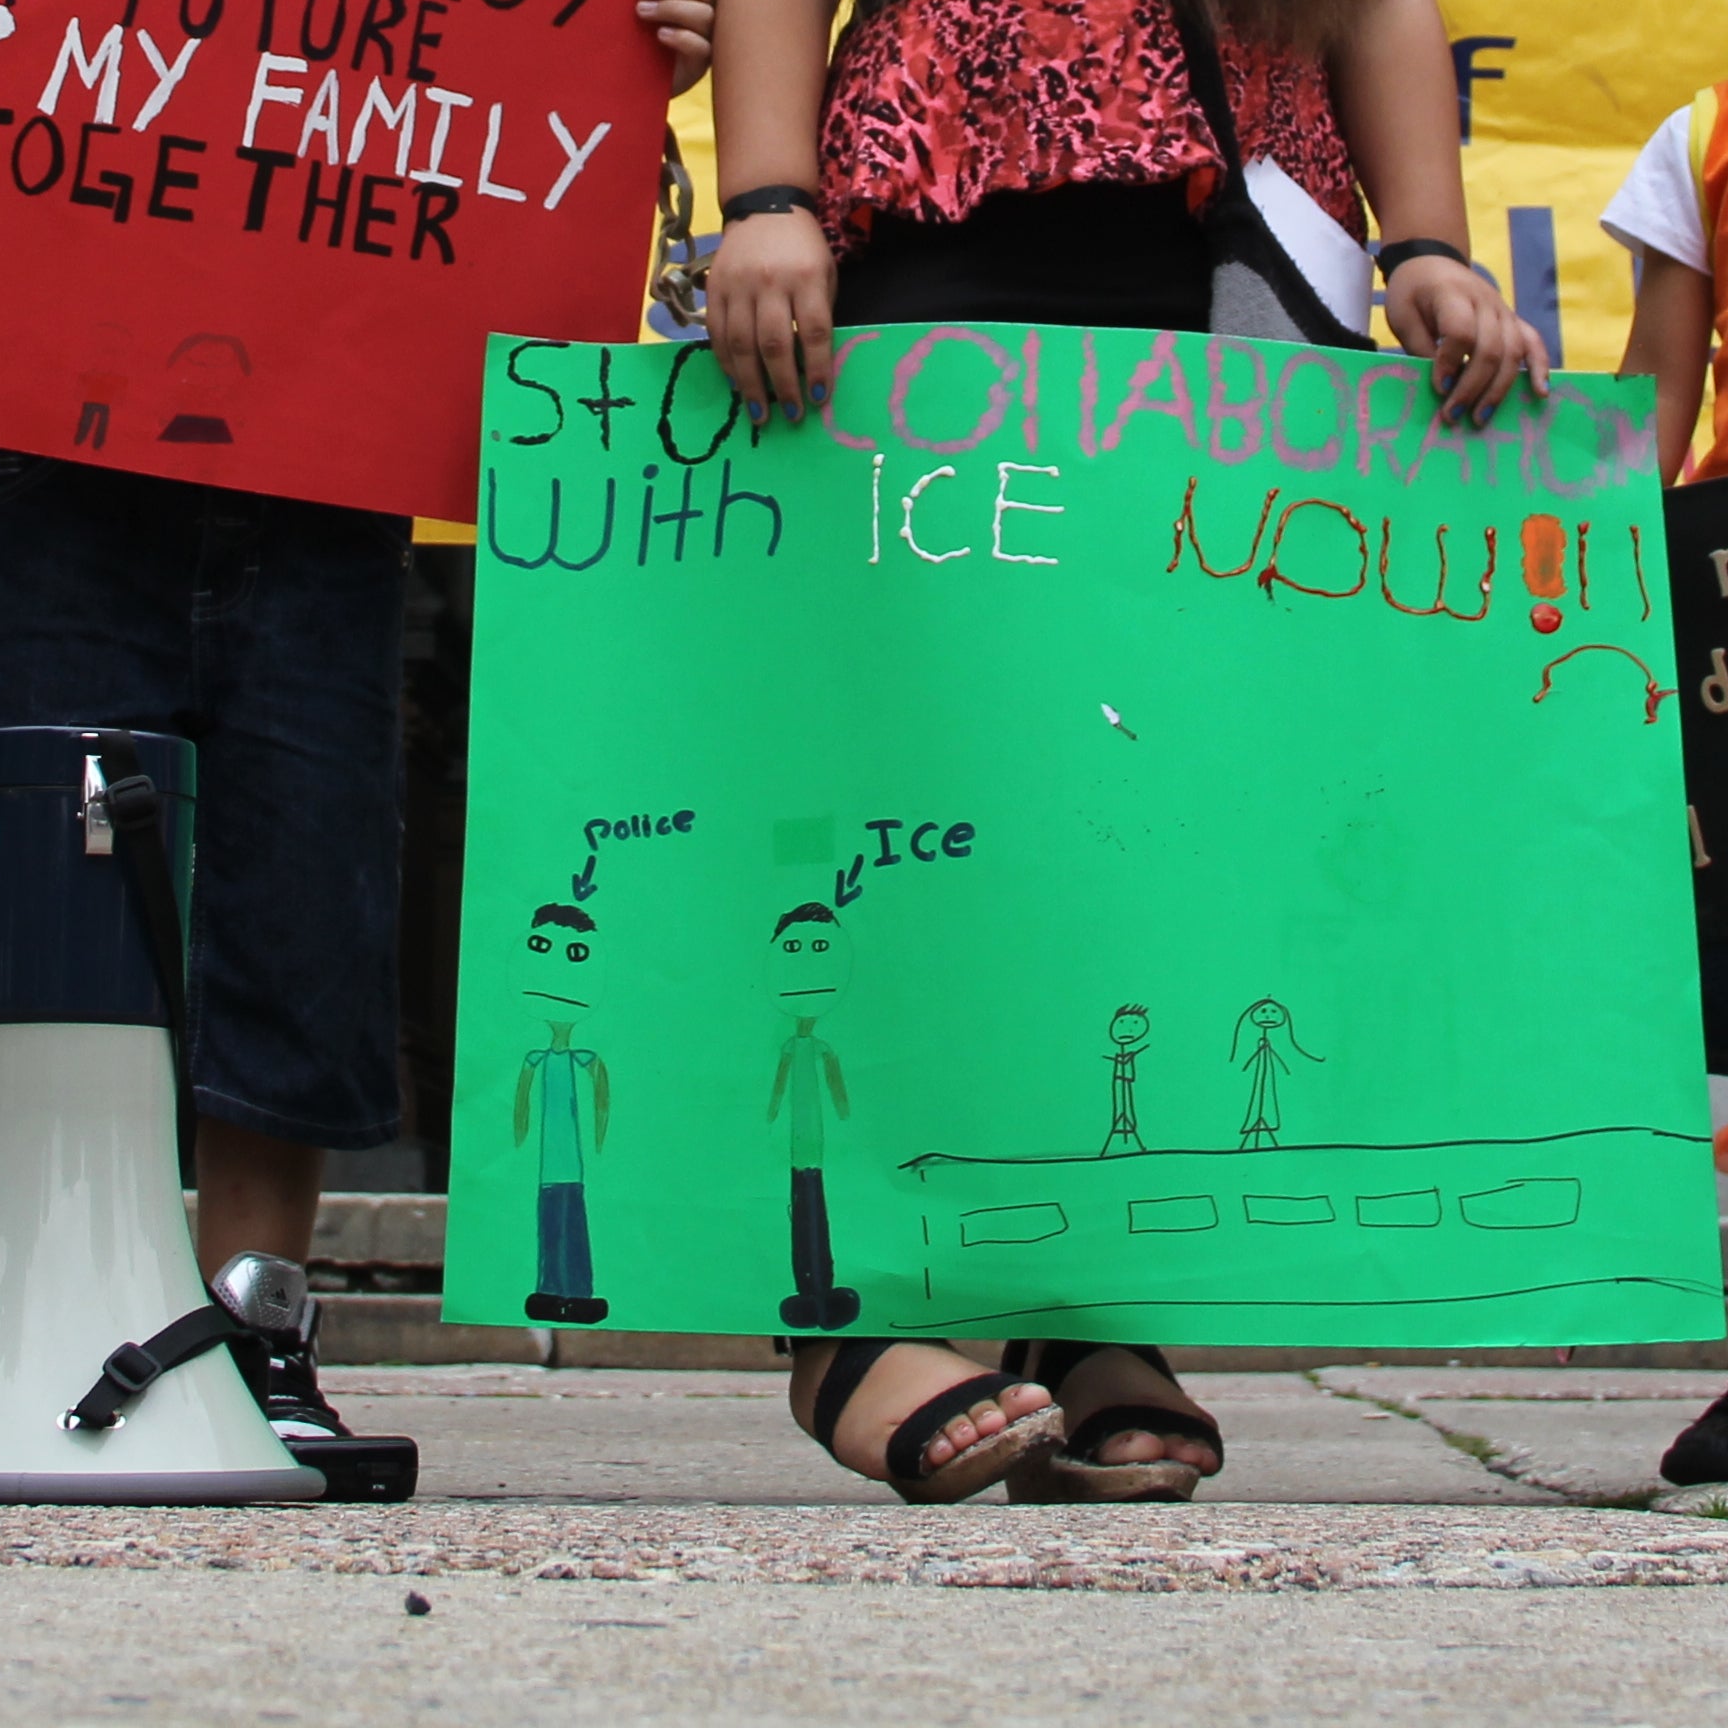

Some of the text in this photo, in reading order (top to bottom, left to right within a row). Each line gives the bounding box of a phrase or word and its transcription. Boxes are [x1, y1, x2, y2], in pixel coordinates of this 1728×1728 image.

[37, 16, 201, 132] MY
[241, 50, 611, 210] FAMILY
[507, 338, 778, 465] Sto
[868, 454, 1066, 565] ICE
